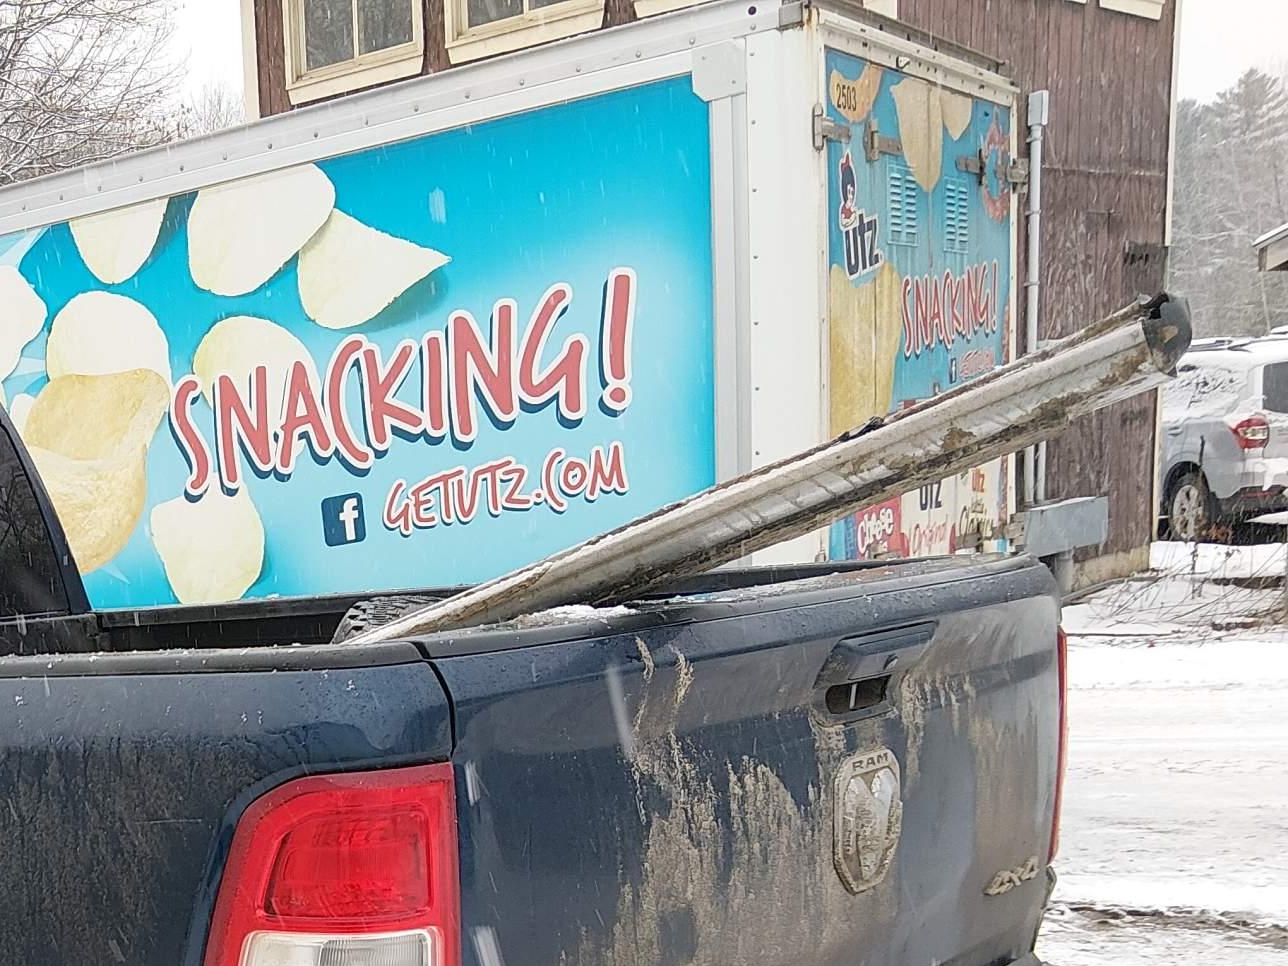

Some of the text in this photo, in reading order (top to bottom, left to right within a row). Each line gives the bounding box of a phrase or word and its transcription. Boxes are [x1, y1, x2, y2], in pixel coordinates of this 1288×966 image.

[836, 83, 857, 112] 2503
[170, 266, 636, 502] SNACKING!
[383, 440, 629, 537] GETUTZ.COM
[852, 752, 889, 772] RAM
